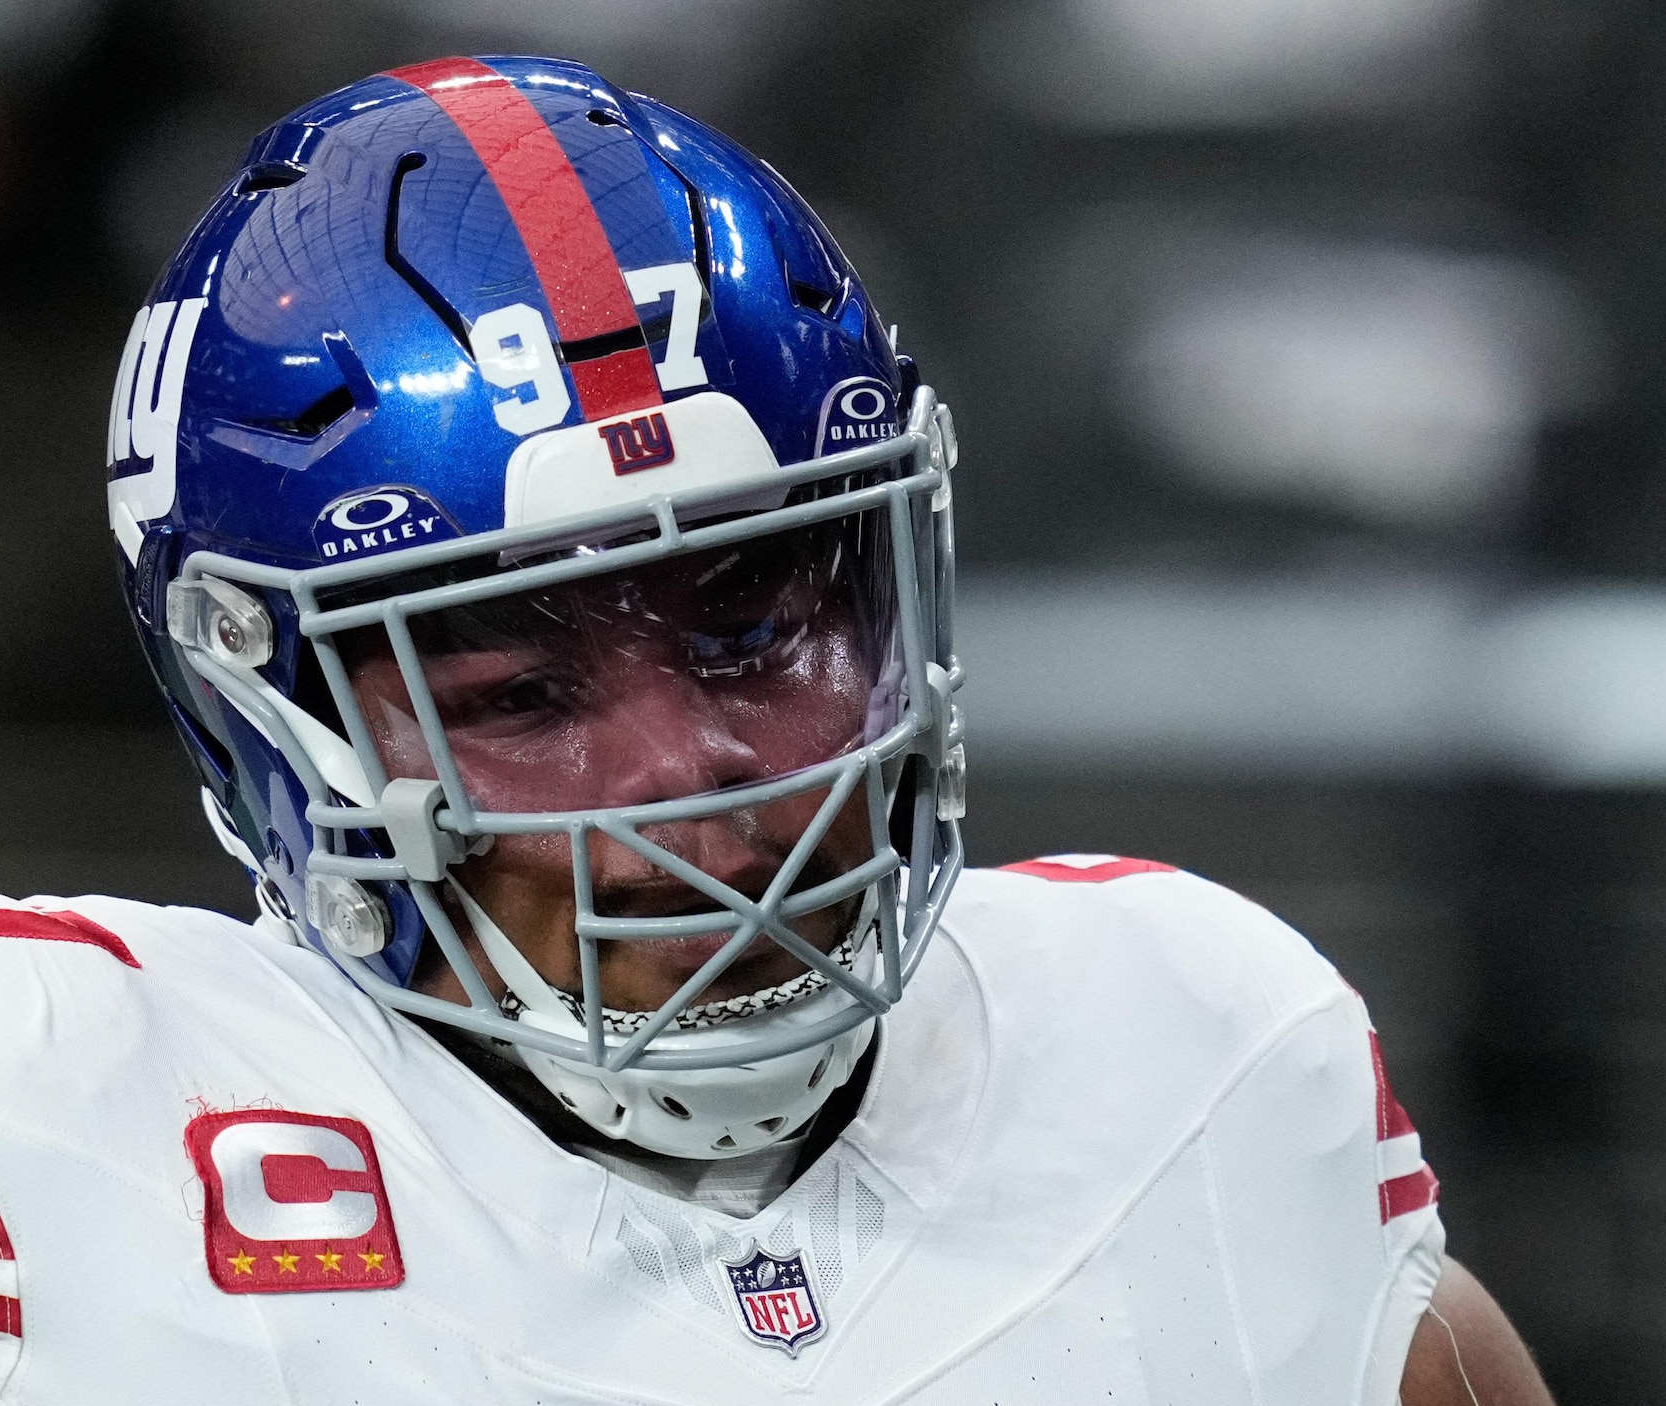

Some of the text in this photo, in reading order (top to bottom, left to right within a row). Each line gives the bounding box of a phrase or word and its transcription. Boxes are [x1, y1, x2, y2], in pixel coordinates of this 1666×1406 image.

[831, 422, 897, 441] OAKLEY
[322, 516, 435, 558] OAKLEY
[209, 1121, 379, 1242] C
[744, 1291, 815, 1336] NFL
